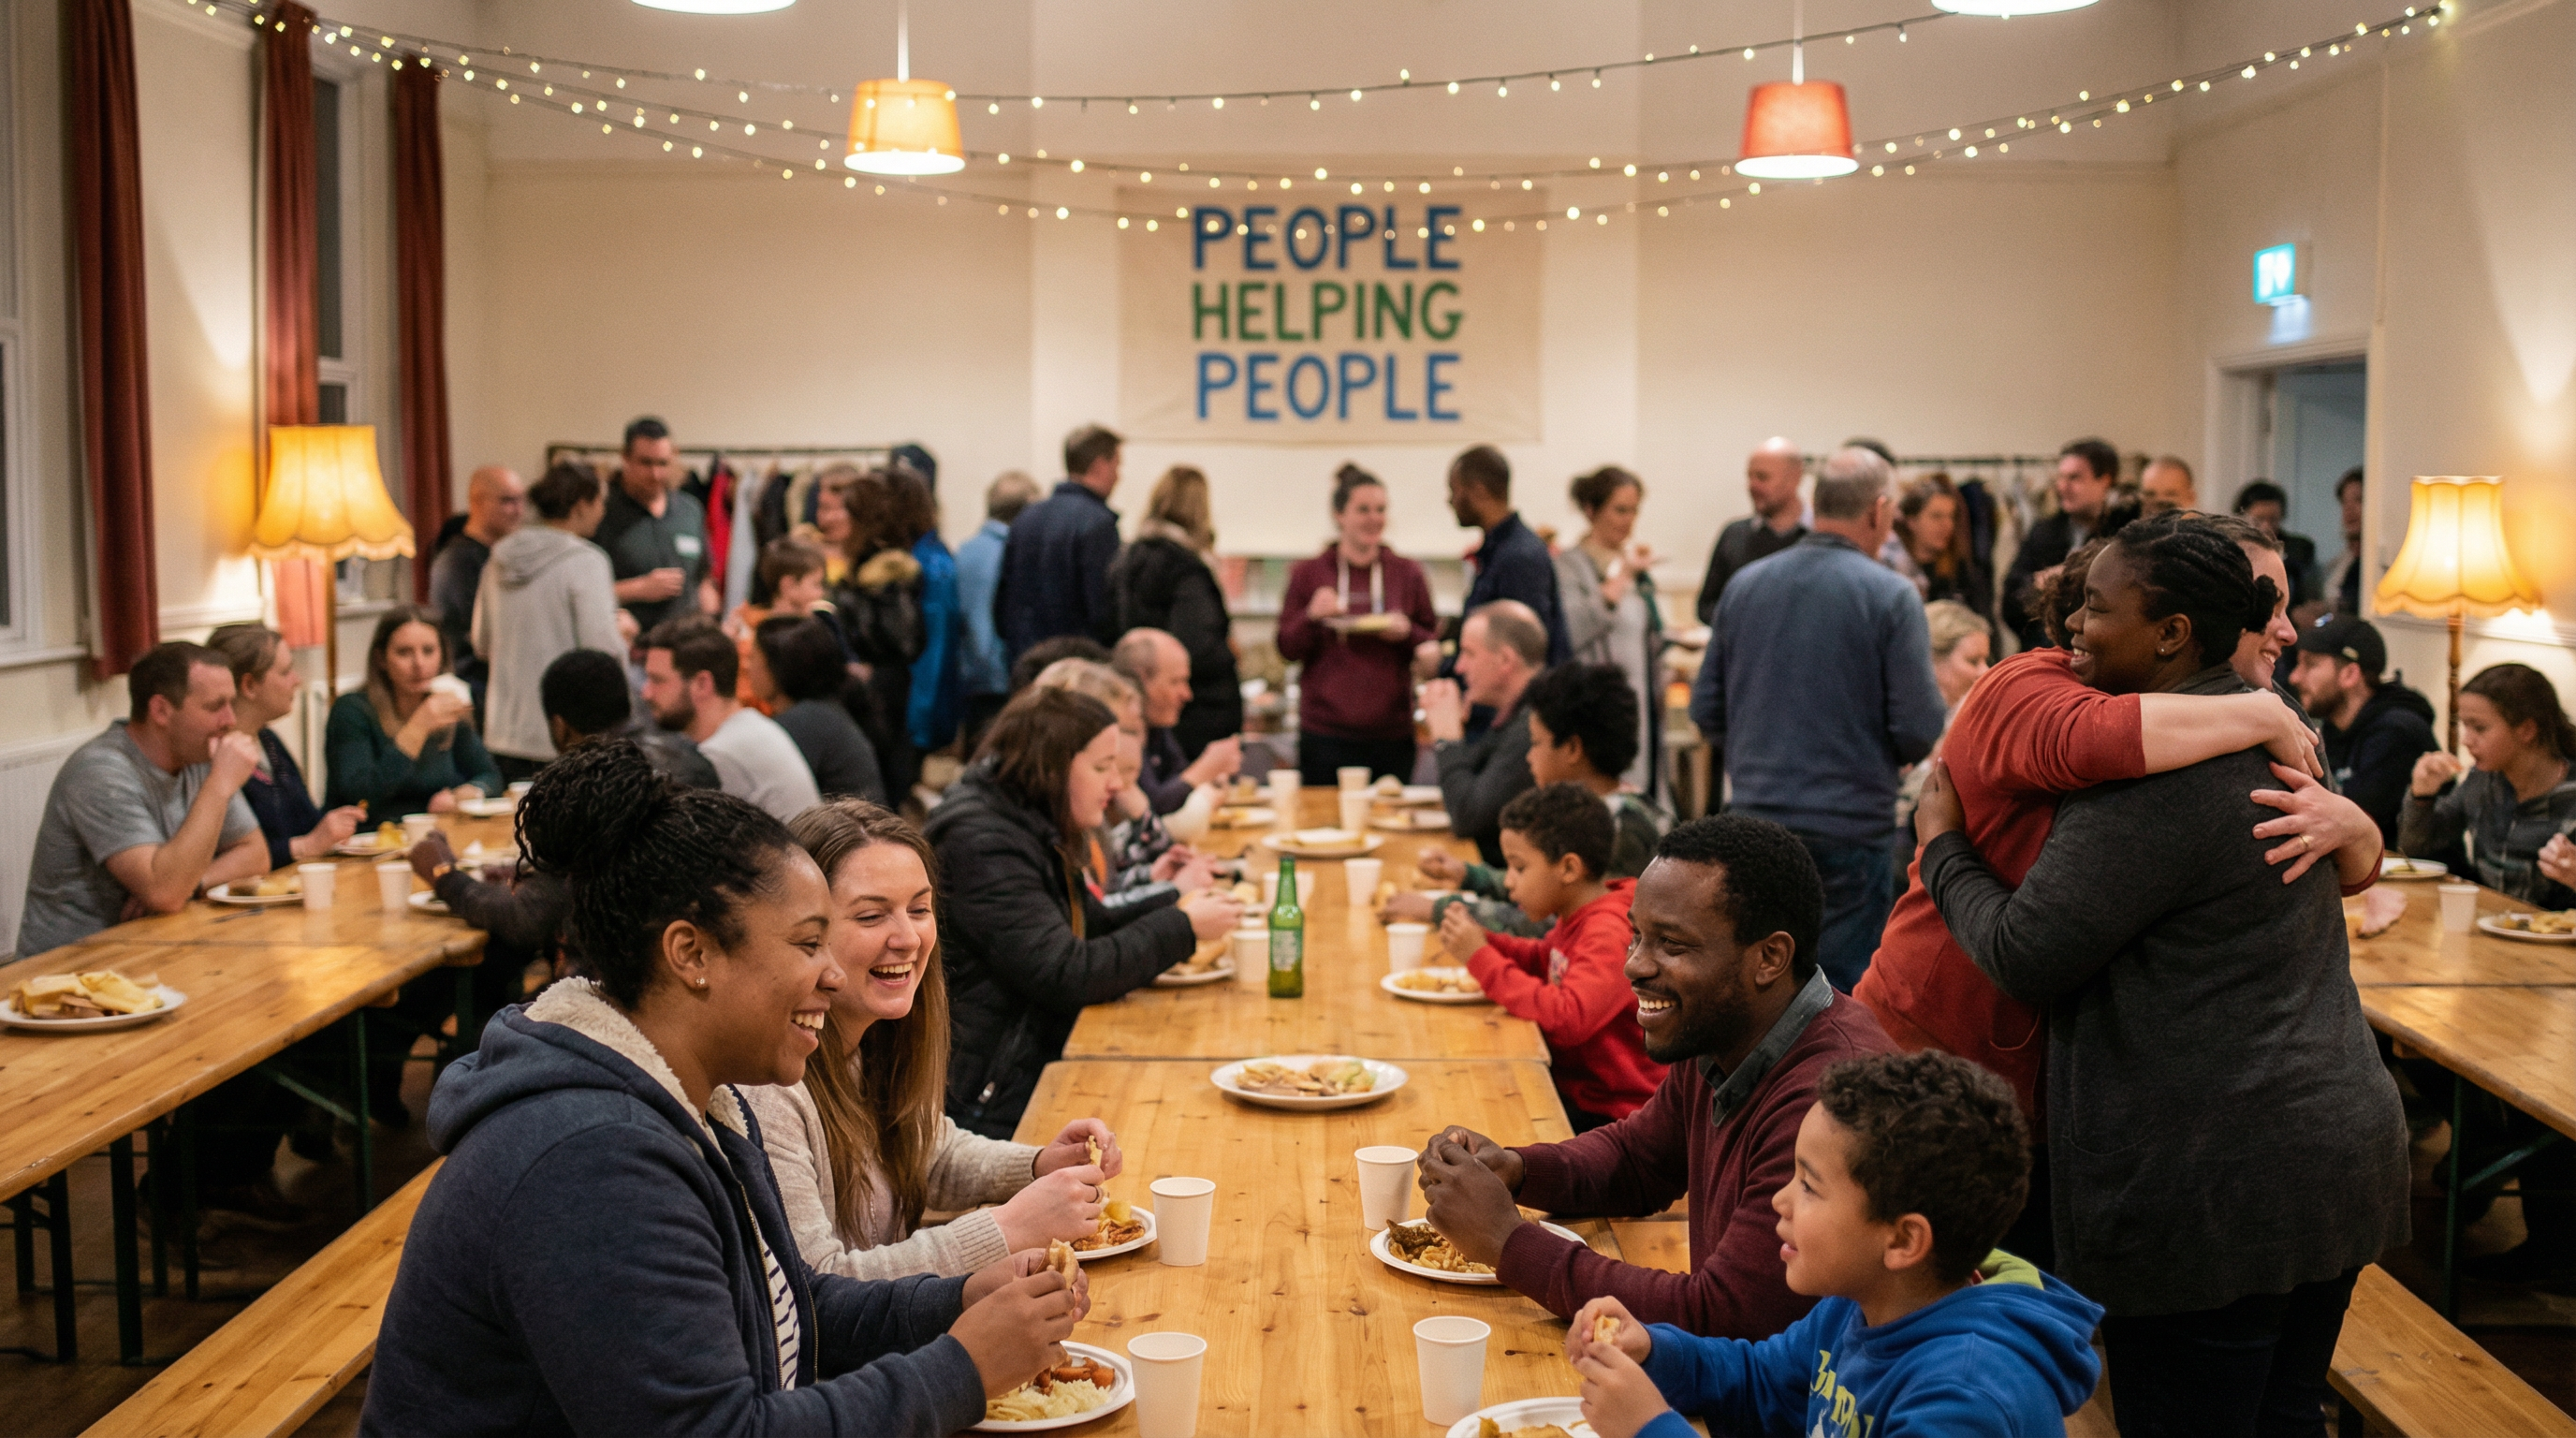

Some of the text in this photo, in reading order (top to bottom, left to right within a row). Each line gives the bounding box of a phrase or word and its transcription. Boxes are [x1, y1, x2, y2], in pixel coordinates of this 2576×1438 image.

[1192, 204, 1462, 271] PEOPLE
[1192, 281, 1464, 342] HELPING
[1197, 352, 1461, 421] PEOPLE
